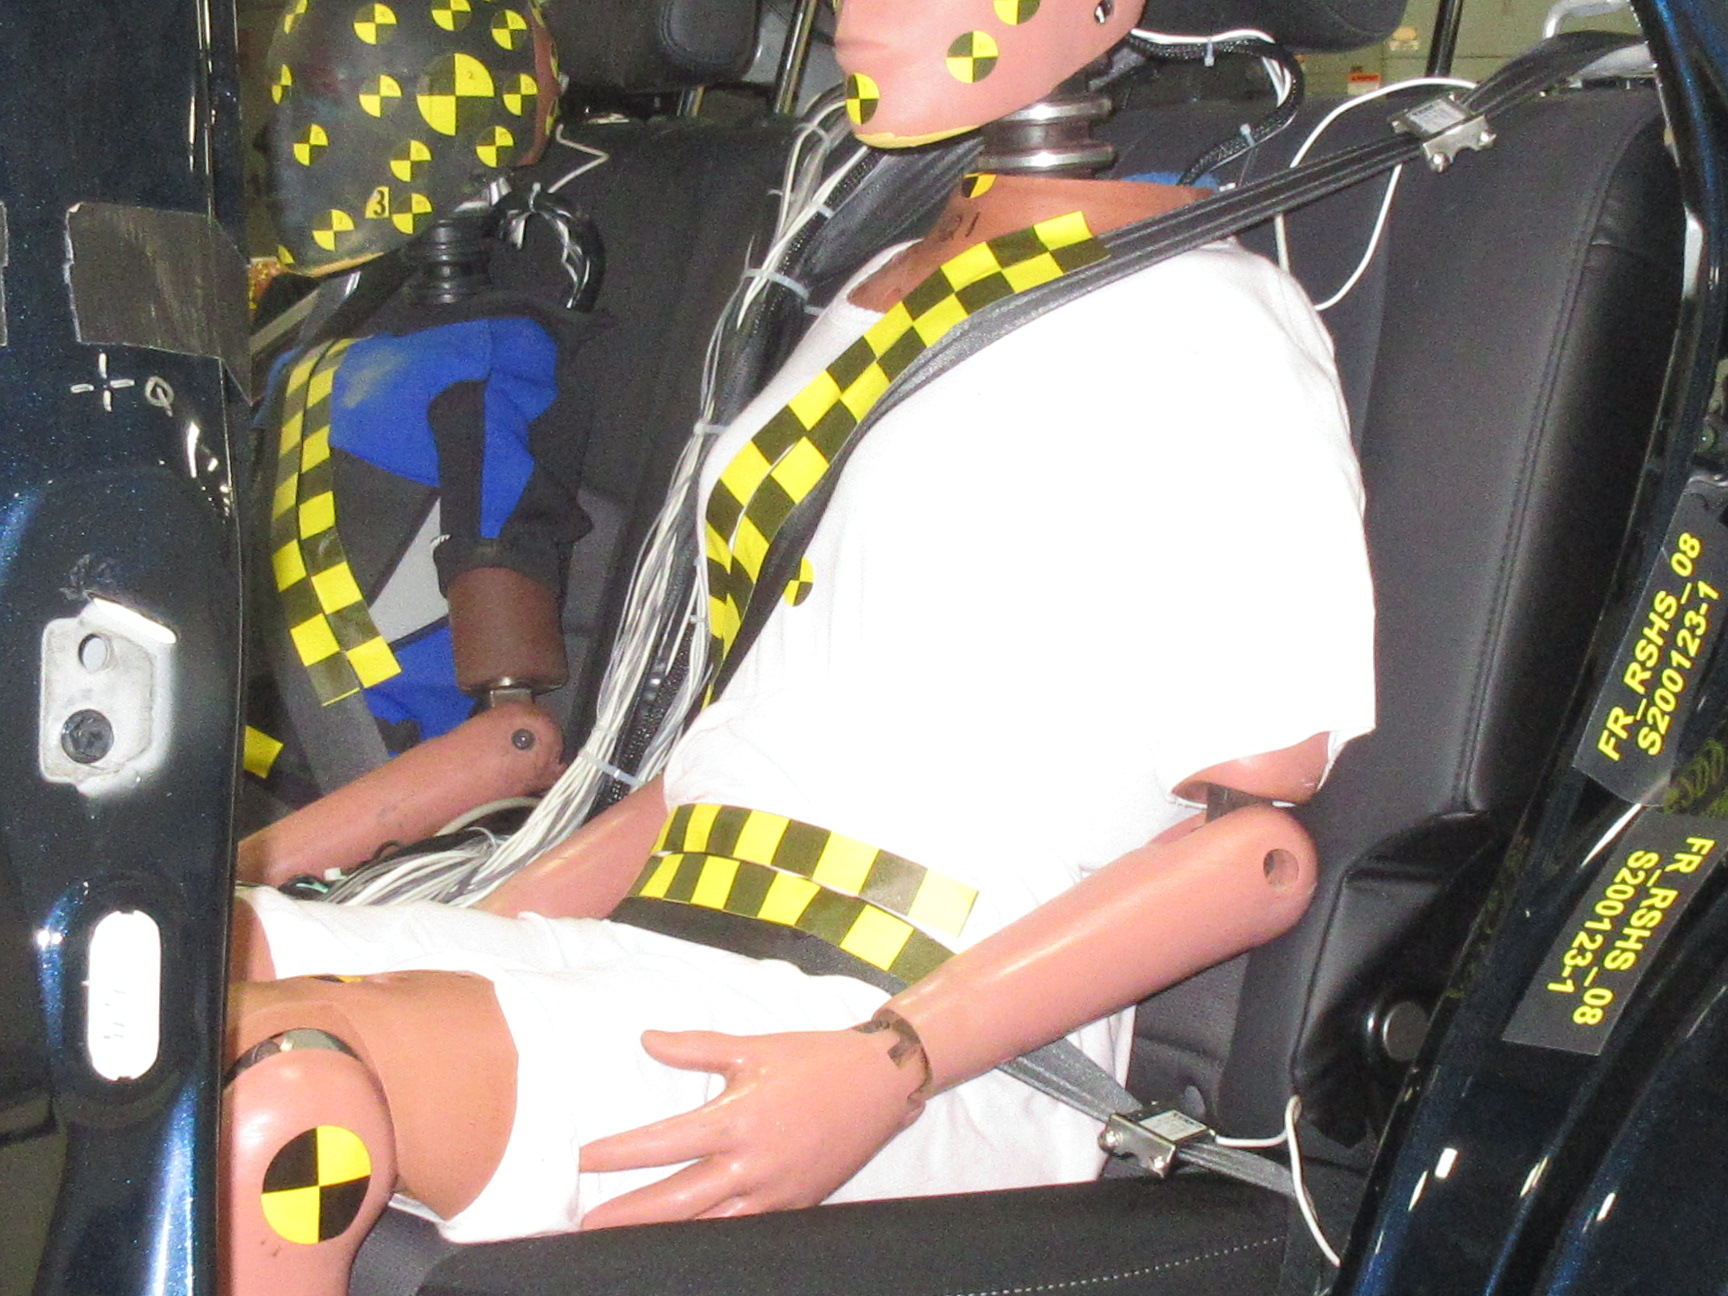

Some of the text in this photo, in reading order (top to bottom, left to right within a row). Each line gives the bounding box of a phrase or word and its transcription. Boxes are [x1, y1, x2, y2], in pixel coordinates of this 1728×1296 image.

[373, 189, 386, 216] 3
[145, 376, 174, 417] Q
[1597, 532, 1701, 761] FR_RSHS_08
[1637, 580, 1720, 756] S200123-1
[1546, 850, 1660, 993] S200123-1
[1572, 836, 1716, 1026] FR_RSHS_08
